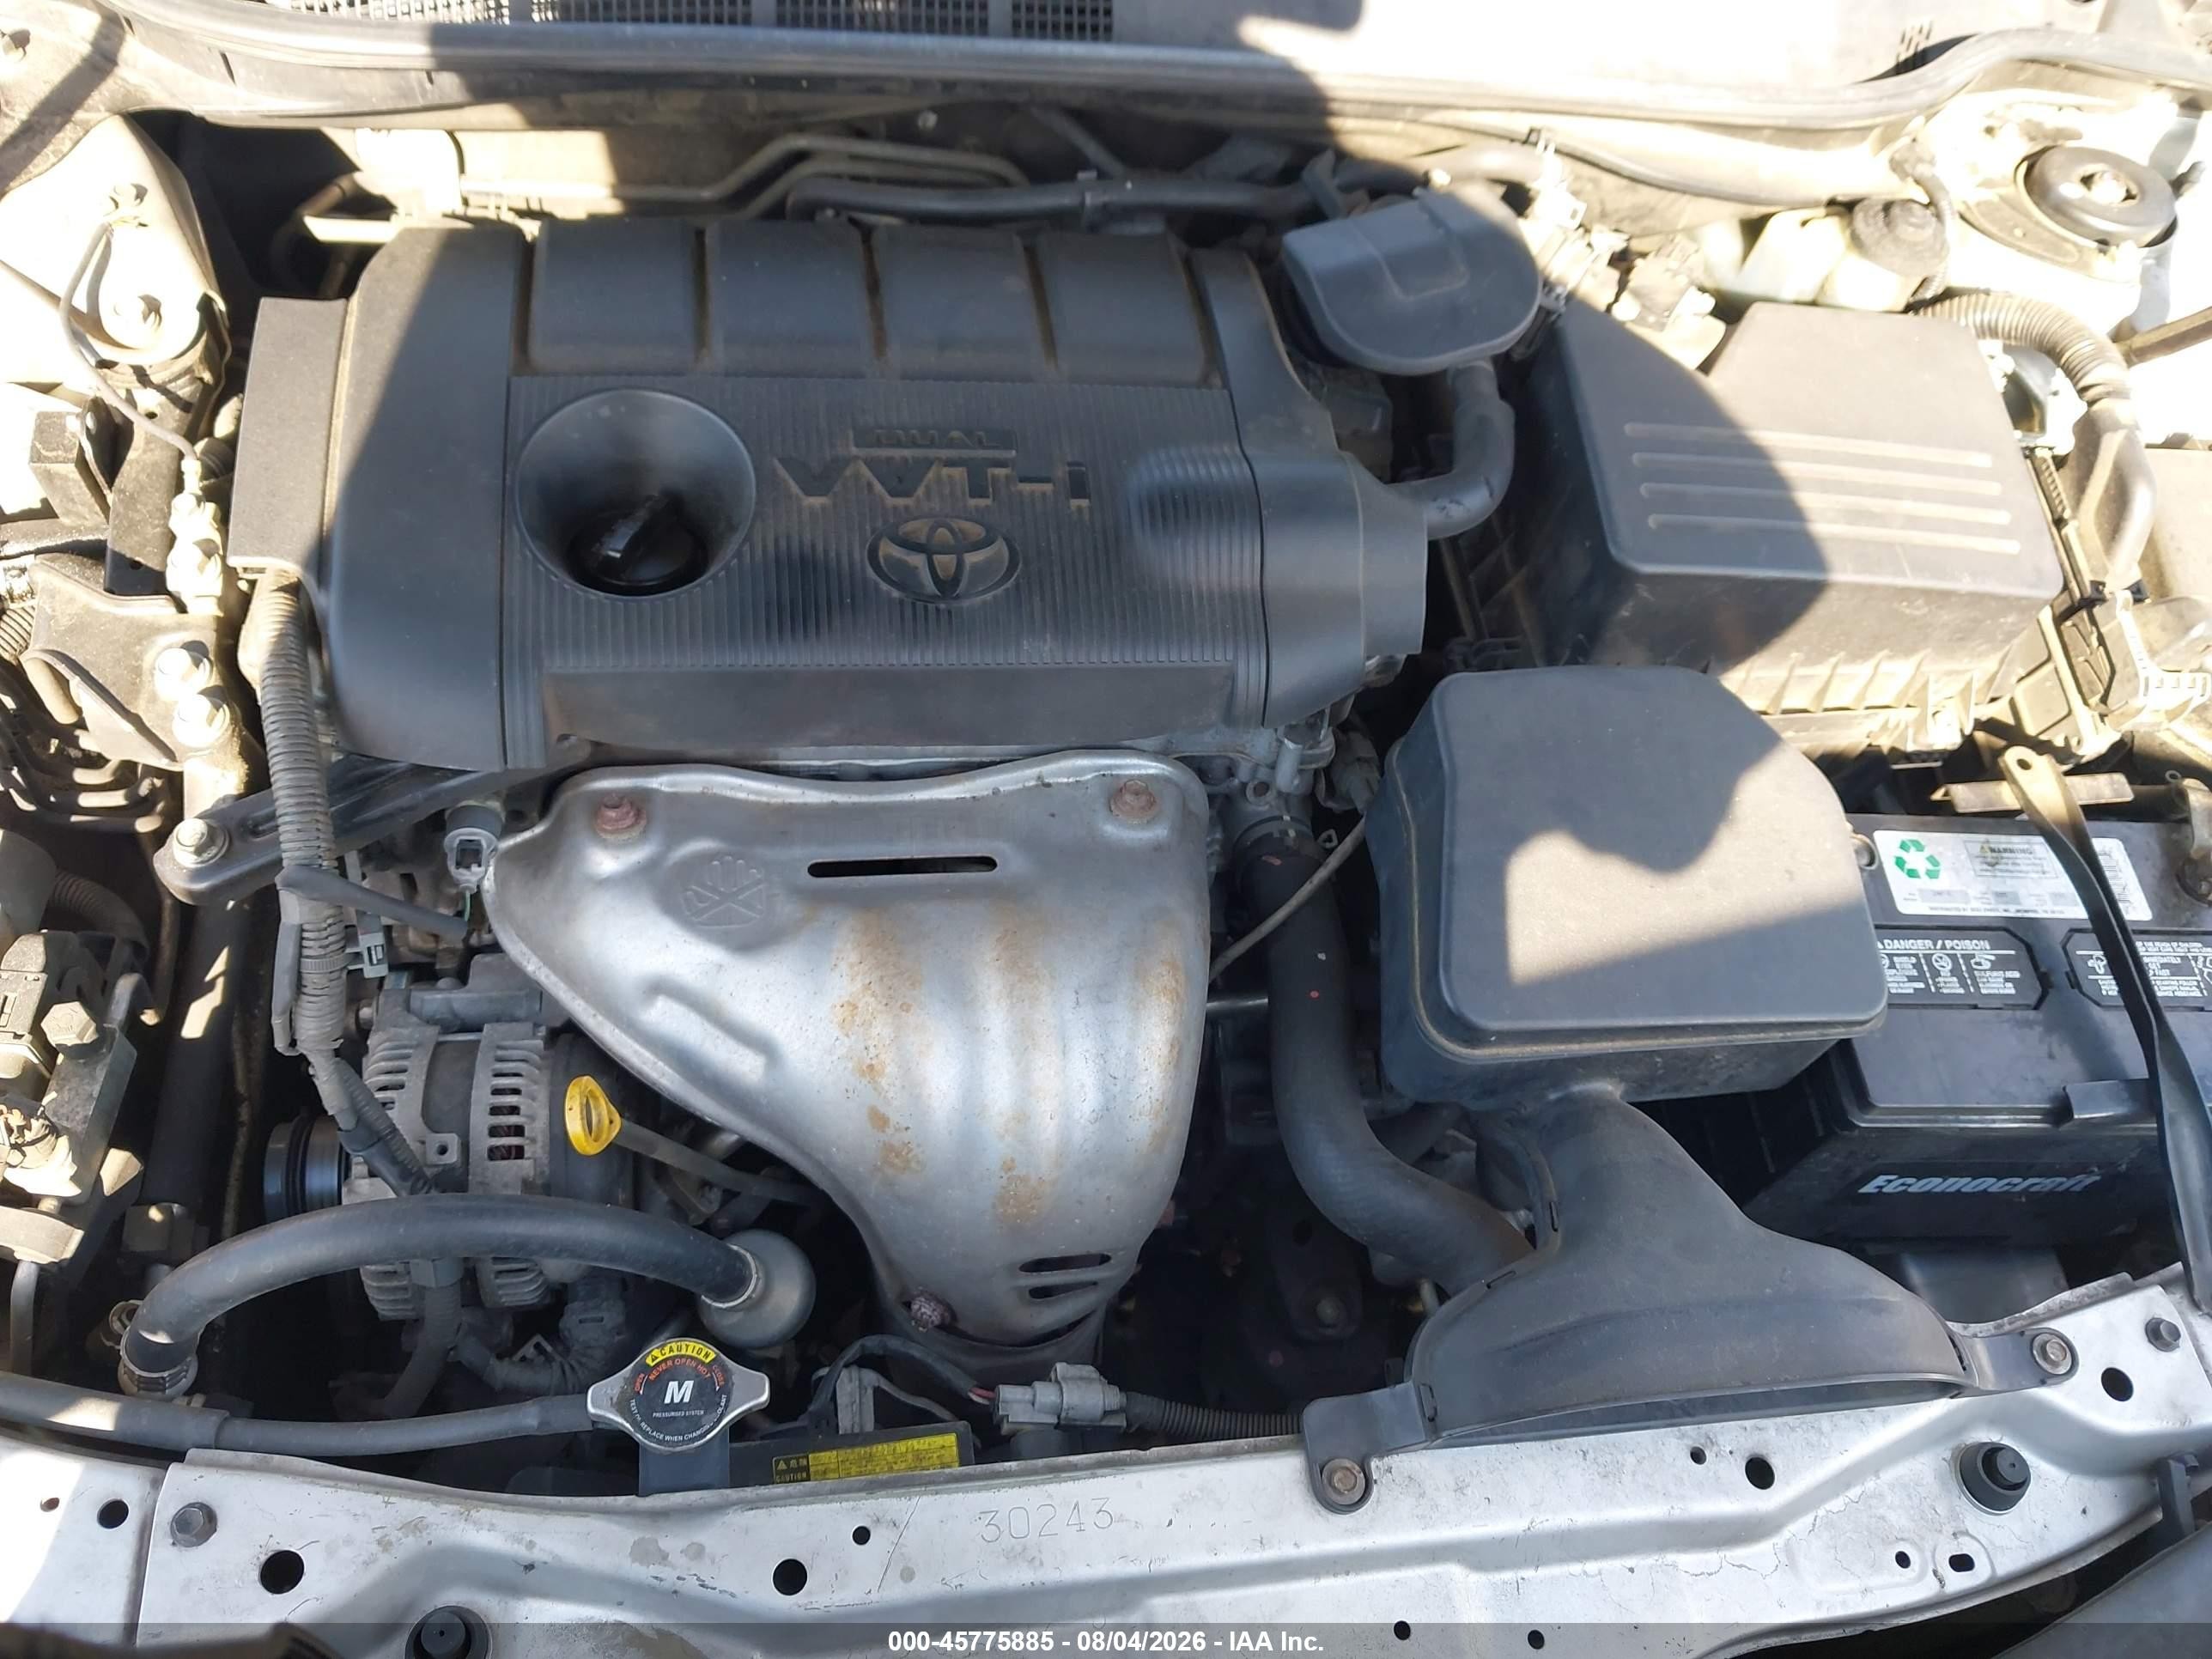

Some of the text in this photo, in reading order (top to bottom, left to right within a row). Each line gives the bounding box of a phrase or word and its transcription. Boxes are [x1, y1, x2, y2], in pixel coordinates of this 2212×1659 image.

[873, 428, 1001, 447] DUAL
[1883, 939, 1990, 950] DANGER / POISON
[1857, 1173, 2102, 1194] Econocraft
[659, 1343, 711, 1359] CAUTION
[648, 1358, 712, 1381] NEVER OPEN HOT
[712, 1364, 726, 1386] CLOSE
[664, 1380, 695, 1404] M
[629, 1399, 639, 1414] TEST
[640, 1421, 664, 1440] REPLACE
[979, 1497, 1114, 1543] 30243
